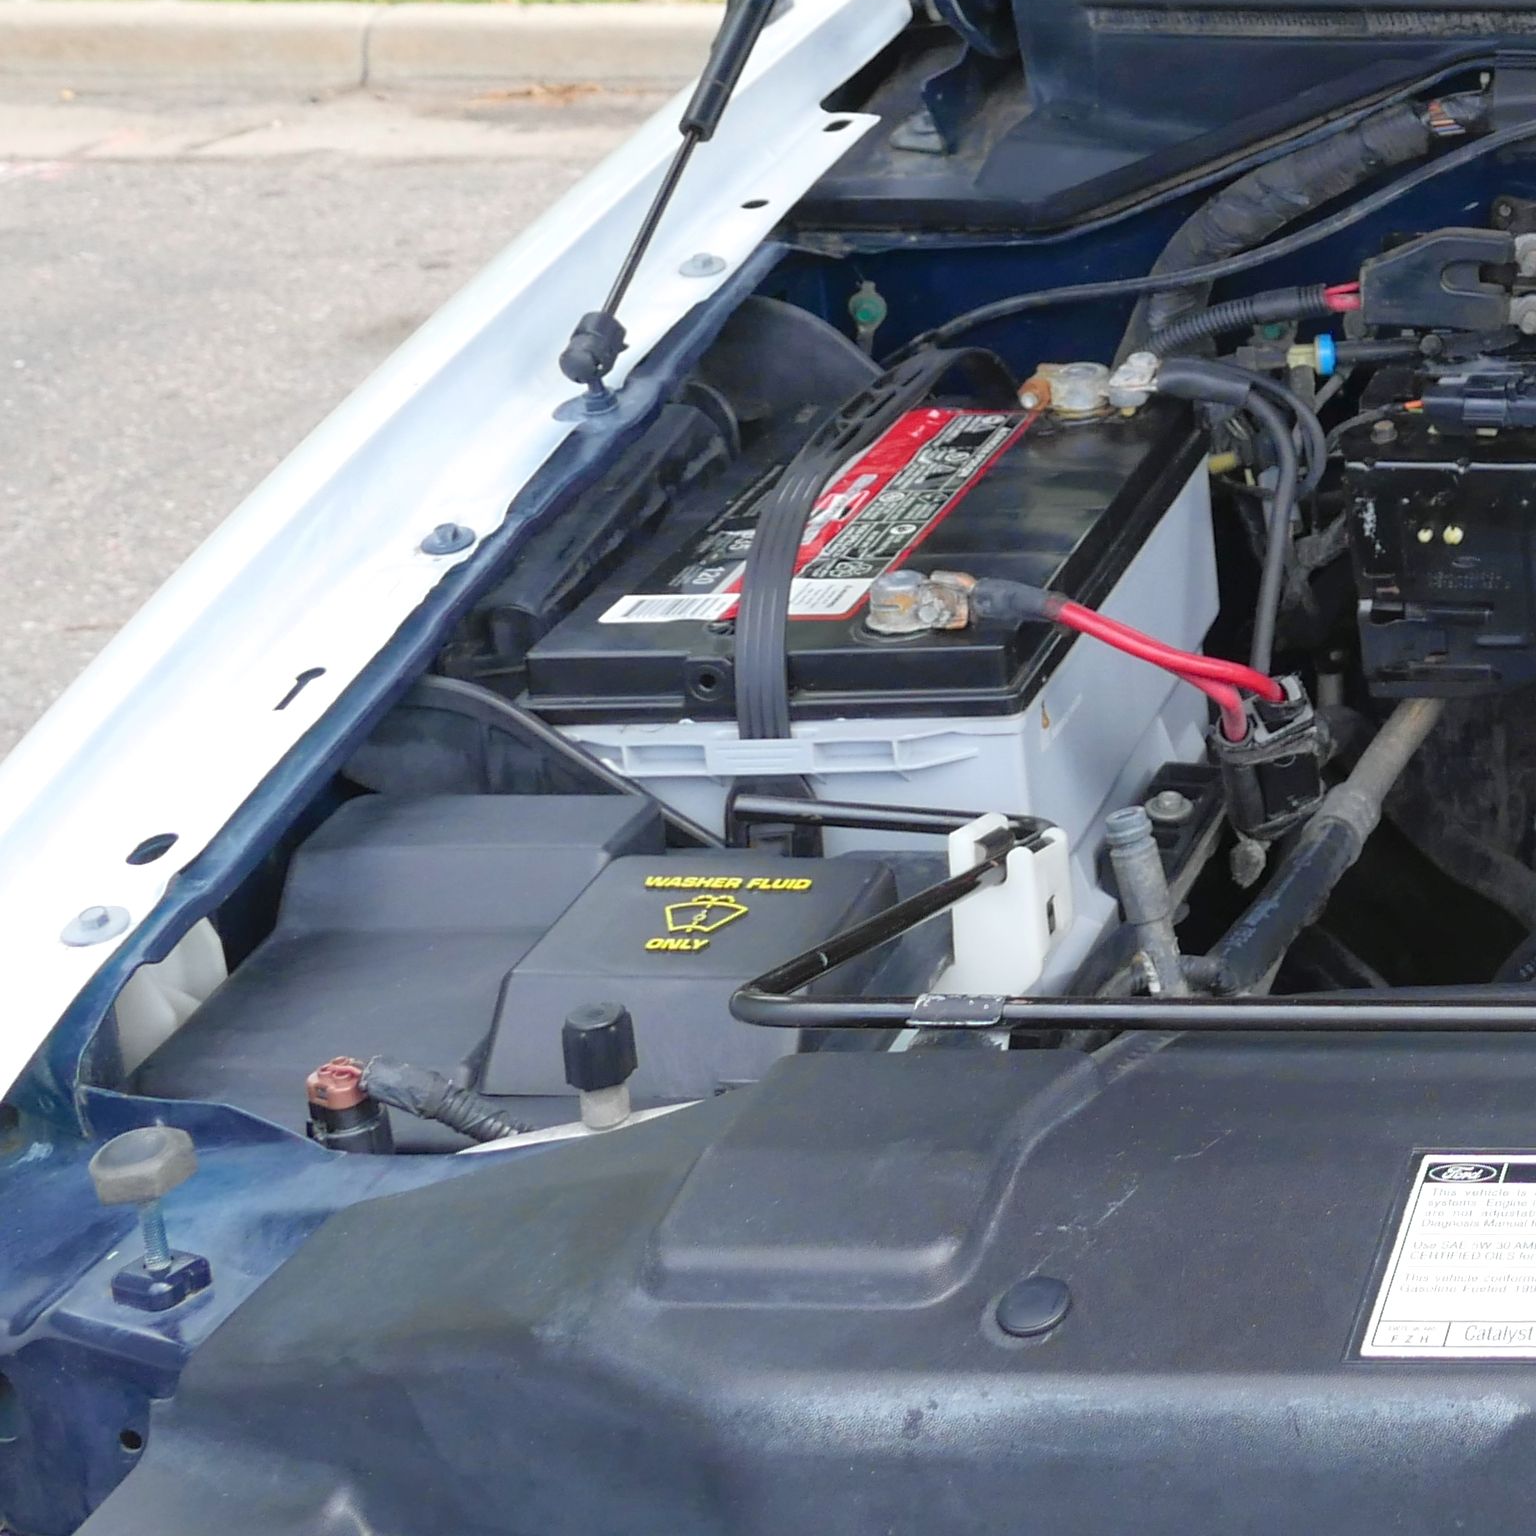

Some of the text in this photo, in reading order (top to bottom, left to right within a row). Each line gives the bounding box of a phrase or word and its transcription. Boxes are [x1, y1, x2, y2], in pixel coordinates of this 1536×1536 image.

[692, 566, 725, 585] 120
[645, 876, 813, 891] WASHER FLUID
[645, 937, 709, 951] ONLY
[1432, 1188, 1456, 1196] This
[1486, 1199, 1527, 1209] Engine
[1421, 1219, 1480, 1228] Diagnosis
[1483, 1219, 1527, 1228] Manual
[1413, 1241, 1437, 1249] Use
[1409, 1252, 1481, 1260] CERTIFIED
[1485, 1252, 1515, 1260] OILS
[1405, 1273, 1429, 1282] This
[1464, 1324, 1534, 1345] Catalyst
